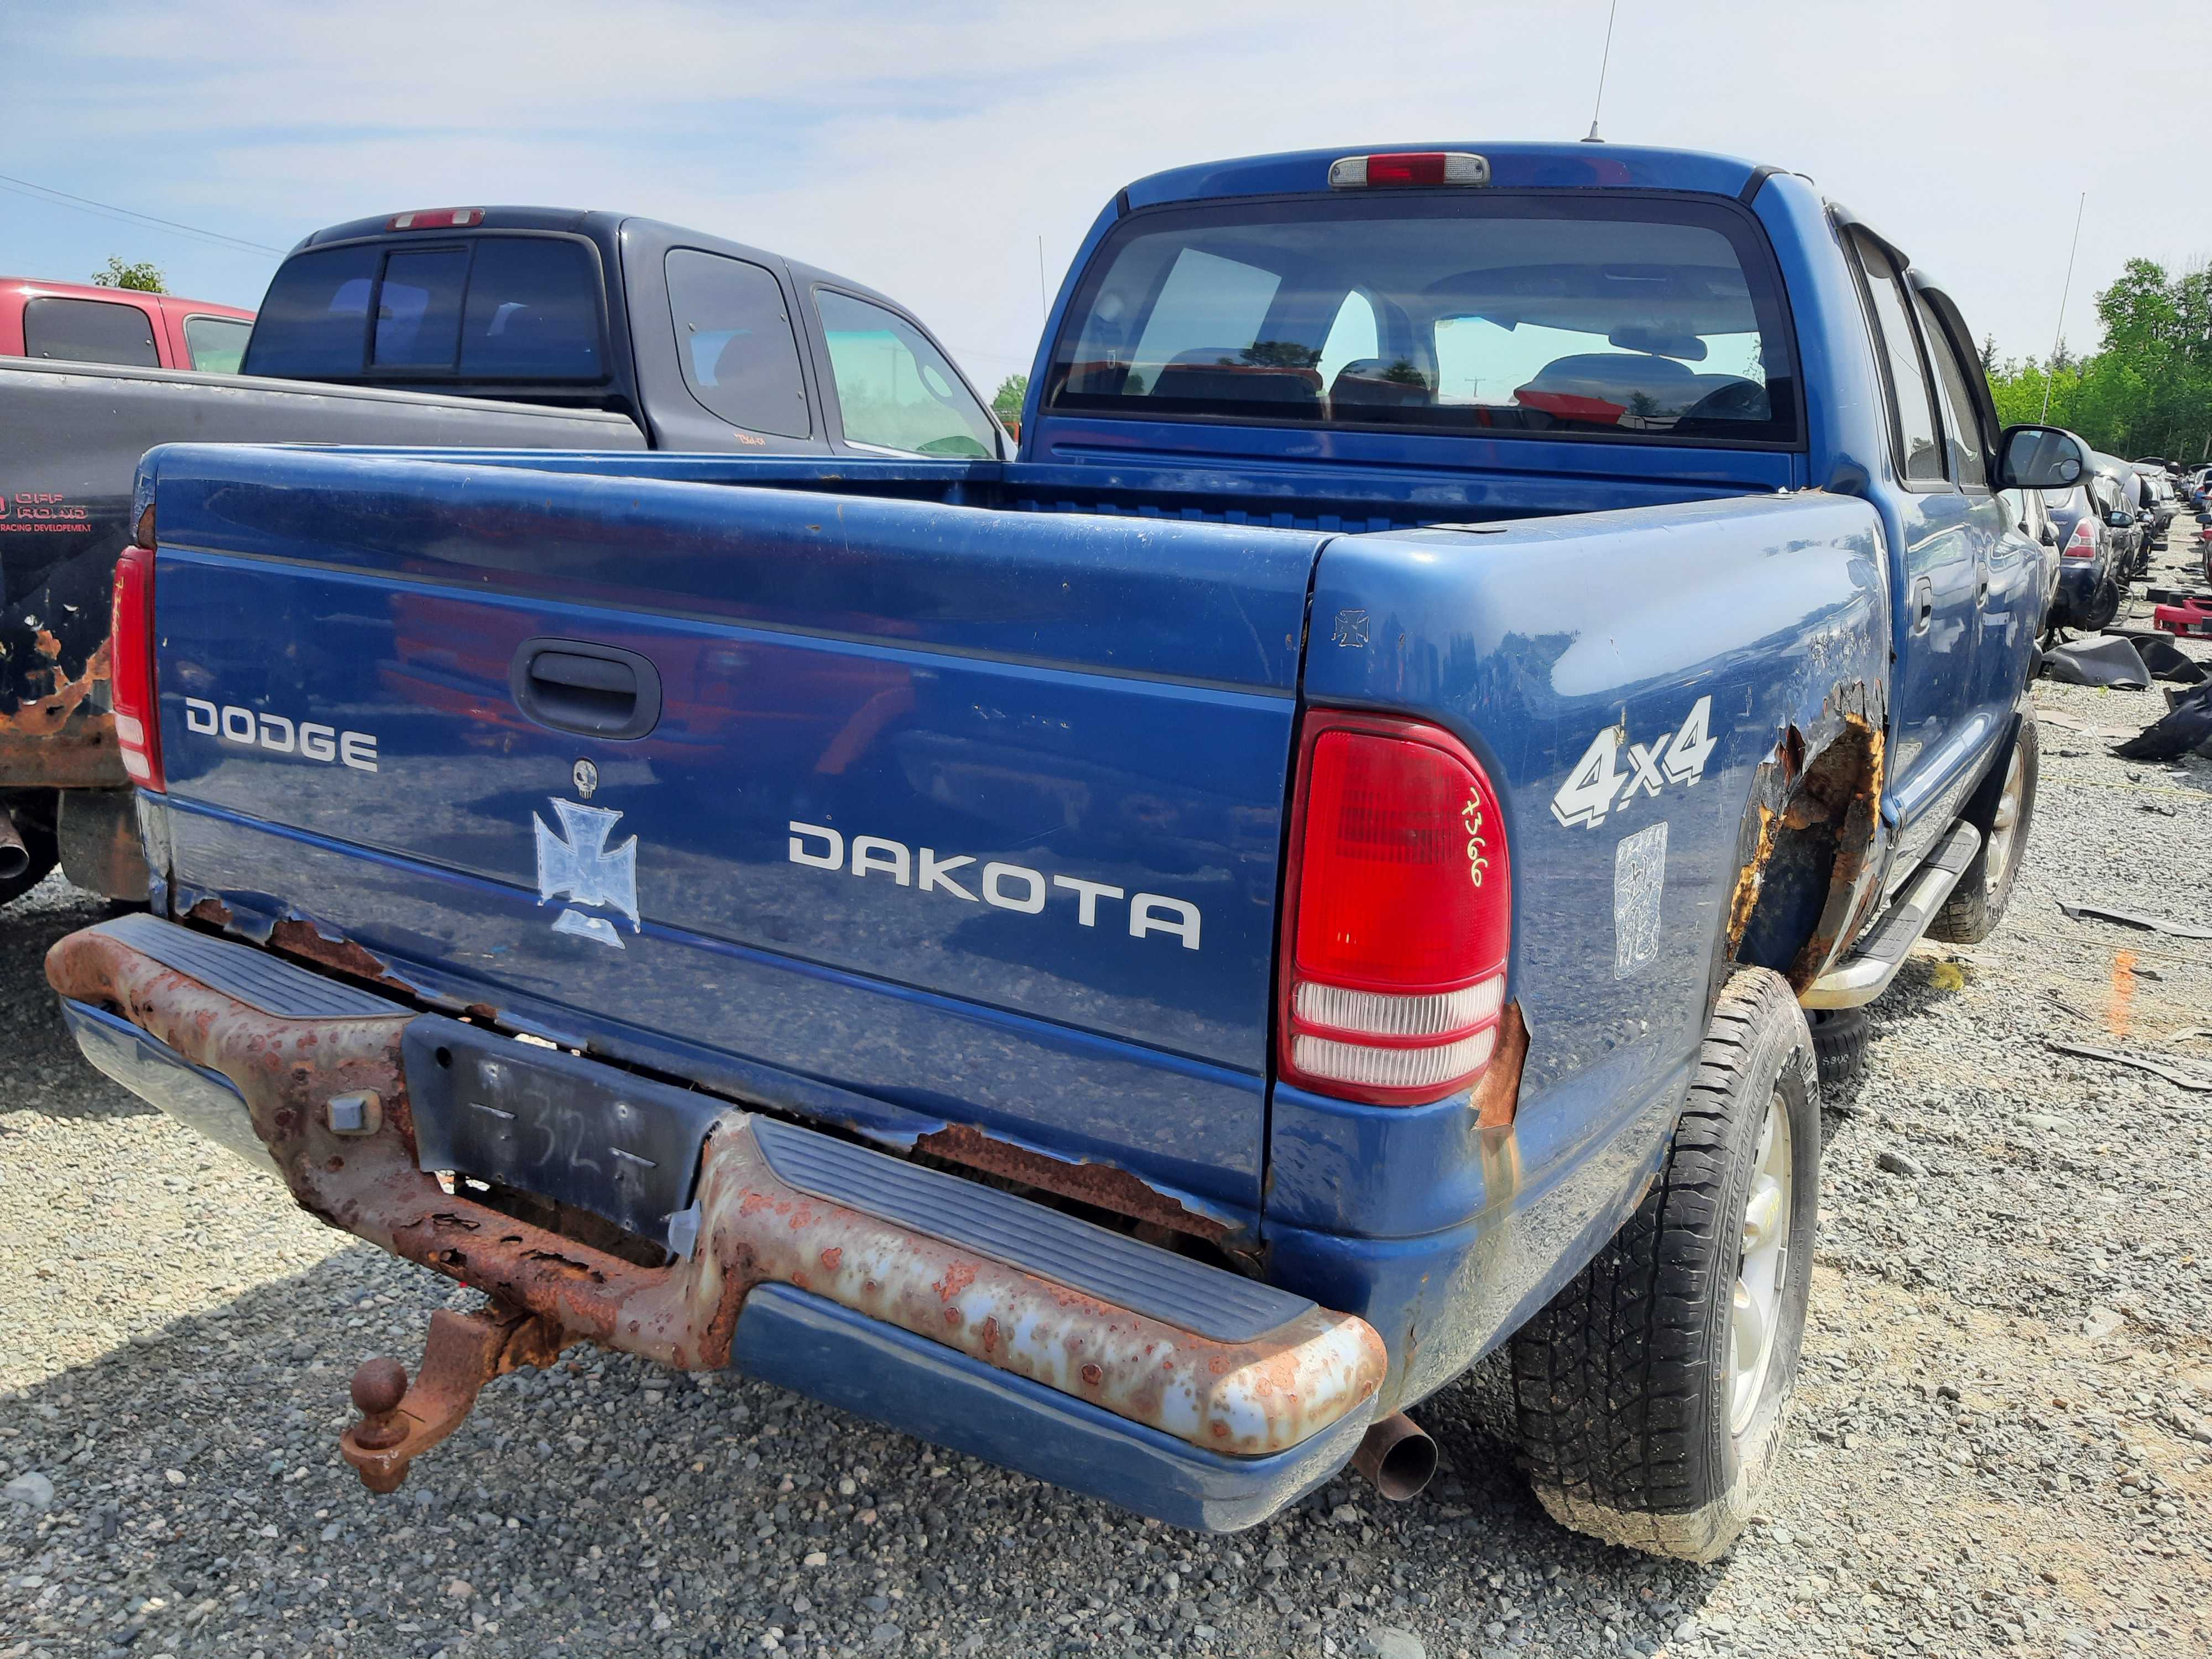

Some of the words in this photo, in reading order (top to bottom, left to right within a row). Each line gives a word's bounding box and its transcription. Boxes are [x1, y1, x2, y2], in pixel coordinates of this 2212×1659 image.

[0, 524, 32, 533] RACING
[34, 524, 92, 533] DEVELOPEMENT
[15, 492, 64, 504] OFF
[186, 697, 378, 773] DODGE
[1461, 786, 1489, 888] 7366
[789, 820, 1201, 951] DAKOTA
